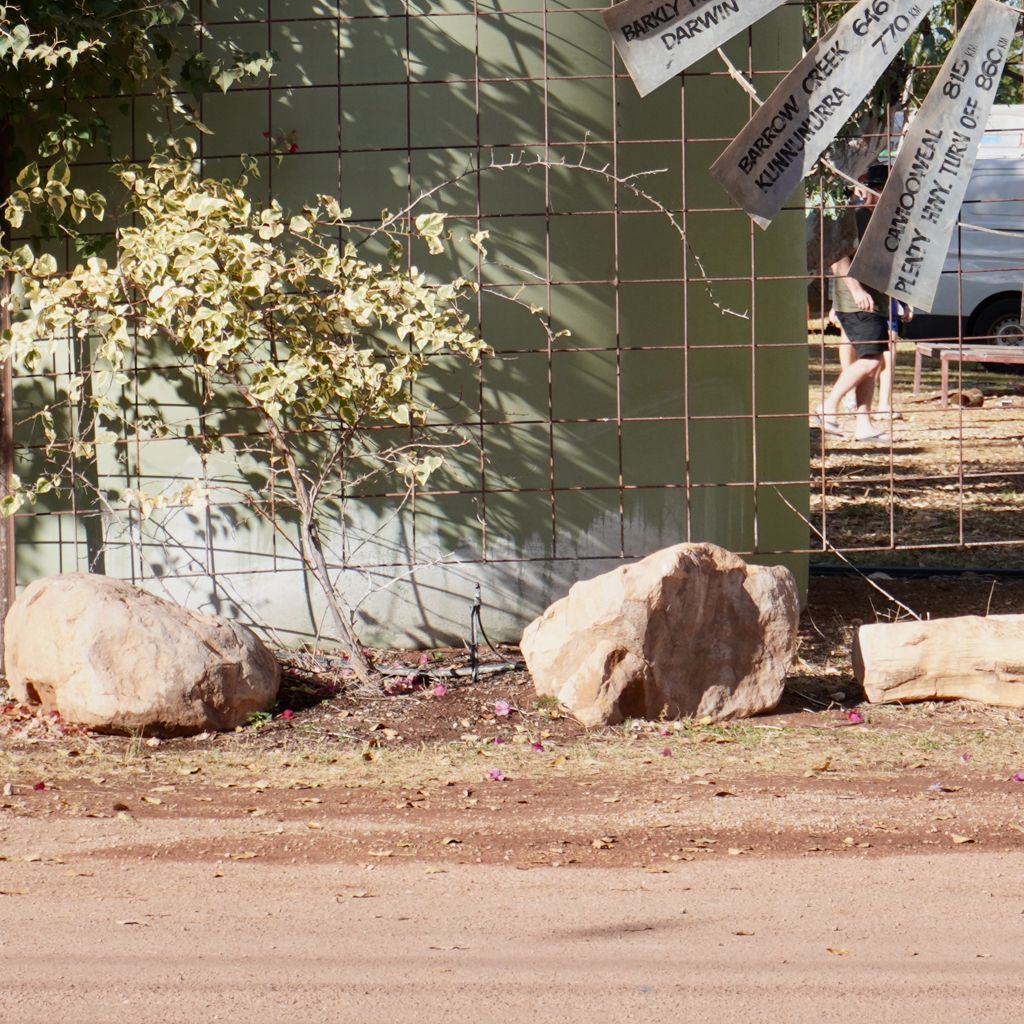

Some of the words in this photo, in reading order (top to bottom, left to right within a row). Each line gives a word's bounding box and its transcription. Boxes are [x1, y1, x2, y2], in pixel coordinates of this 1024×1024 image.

[732, 94, 806, 176] BARROW
[798, 39, 851, 97] CREEK
[751, 82, 850, 194] KUNNUNURRA
[870, 11, 913, 57] 770
[907, 3, 923, 19] KM
[880, 124, 943, 255] CAMOOWEAL
[940, 55, 971, 101] 815
[963, 41, 978, 58] KM
[892, 227, 933, 295] PLENTY
[938, 130, 972, 179] TURN
[958, 95, 985, 130] OFF
[973, 45, 1005, 93] 860
[995, 35, 1009, 49] KM
